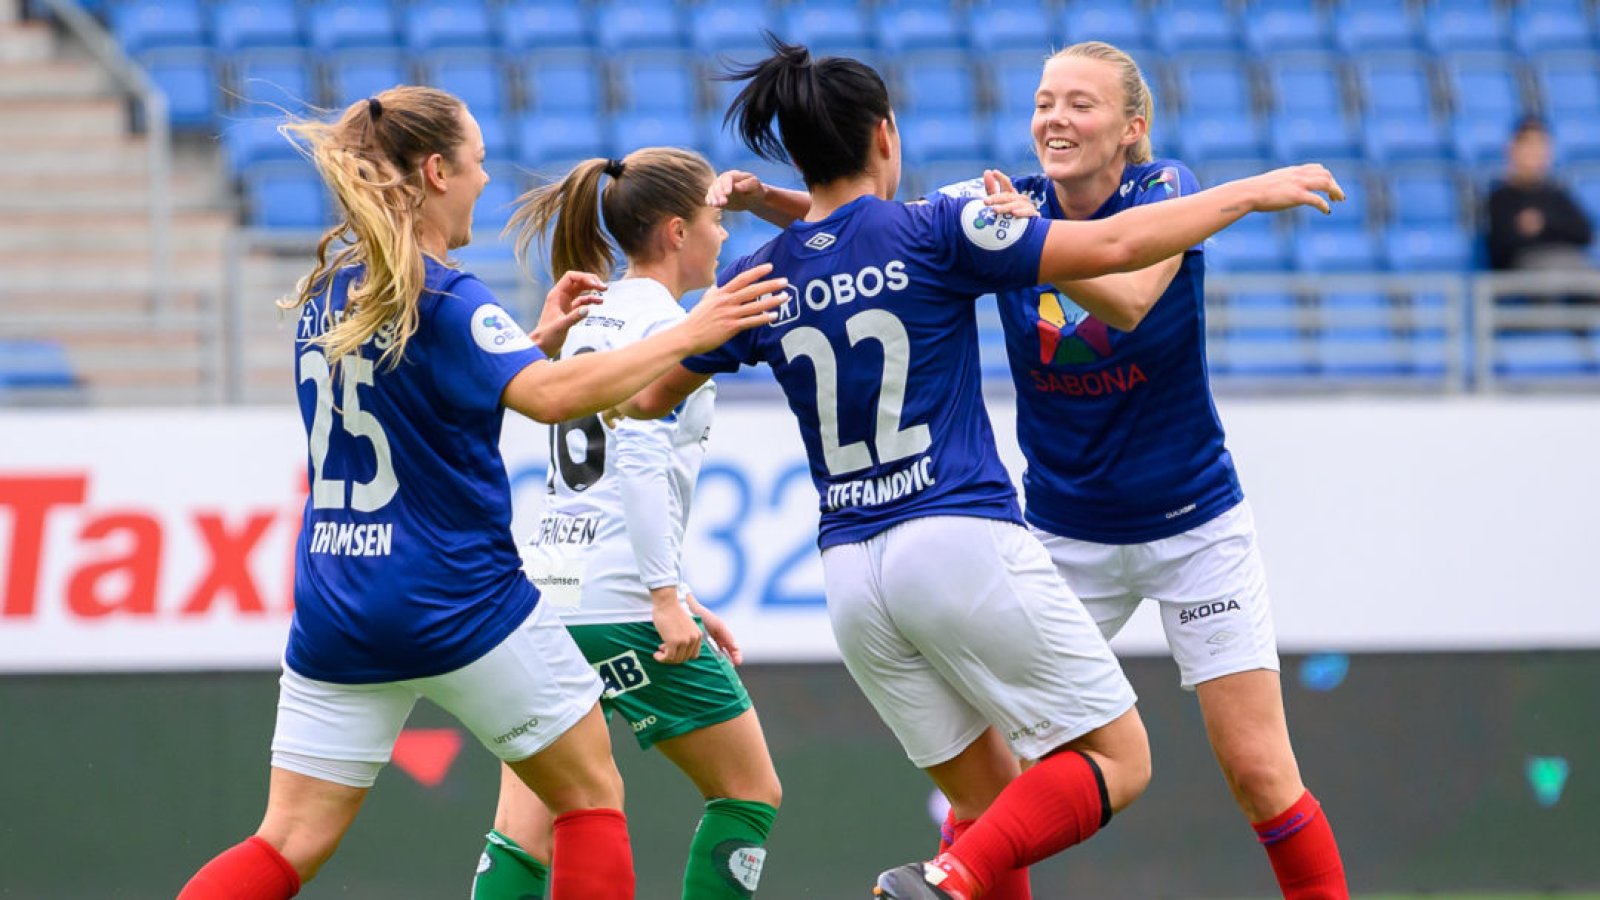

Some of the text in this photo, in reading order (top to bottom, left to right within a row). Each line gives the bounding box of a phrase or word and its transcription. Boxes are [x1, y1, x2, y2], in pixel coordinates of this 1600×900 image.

[804, 260, 909, 311] OBOS
[781, 308, 932, 476] 22
[1030, 363, 1148, 396] SABONA
[300, 350, 399, 513] 25
[310, 521, 392, 557] THOMSEN
[1179, 600, 1240, 625] ŠKODA
[492, 718, 538, 744] umbro
[631, 715, 657, 732] bro
